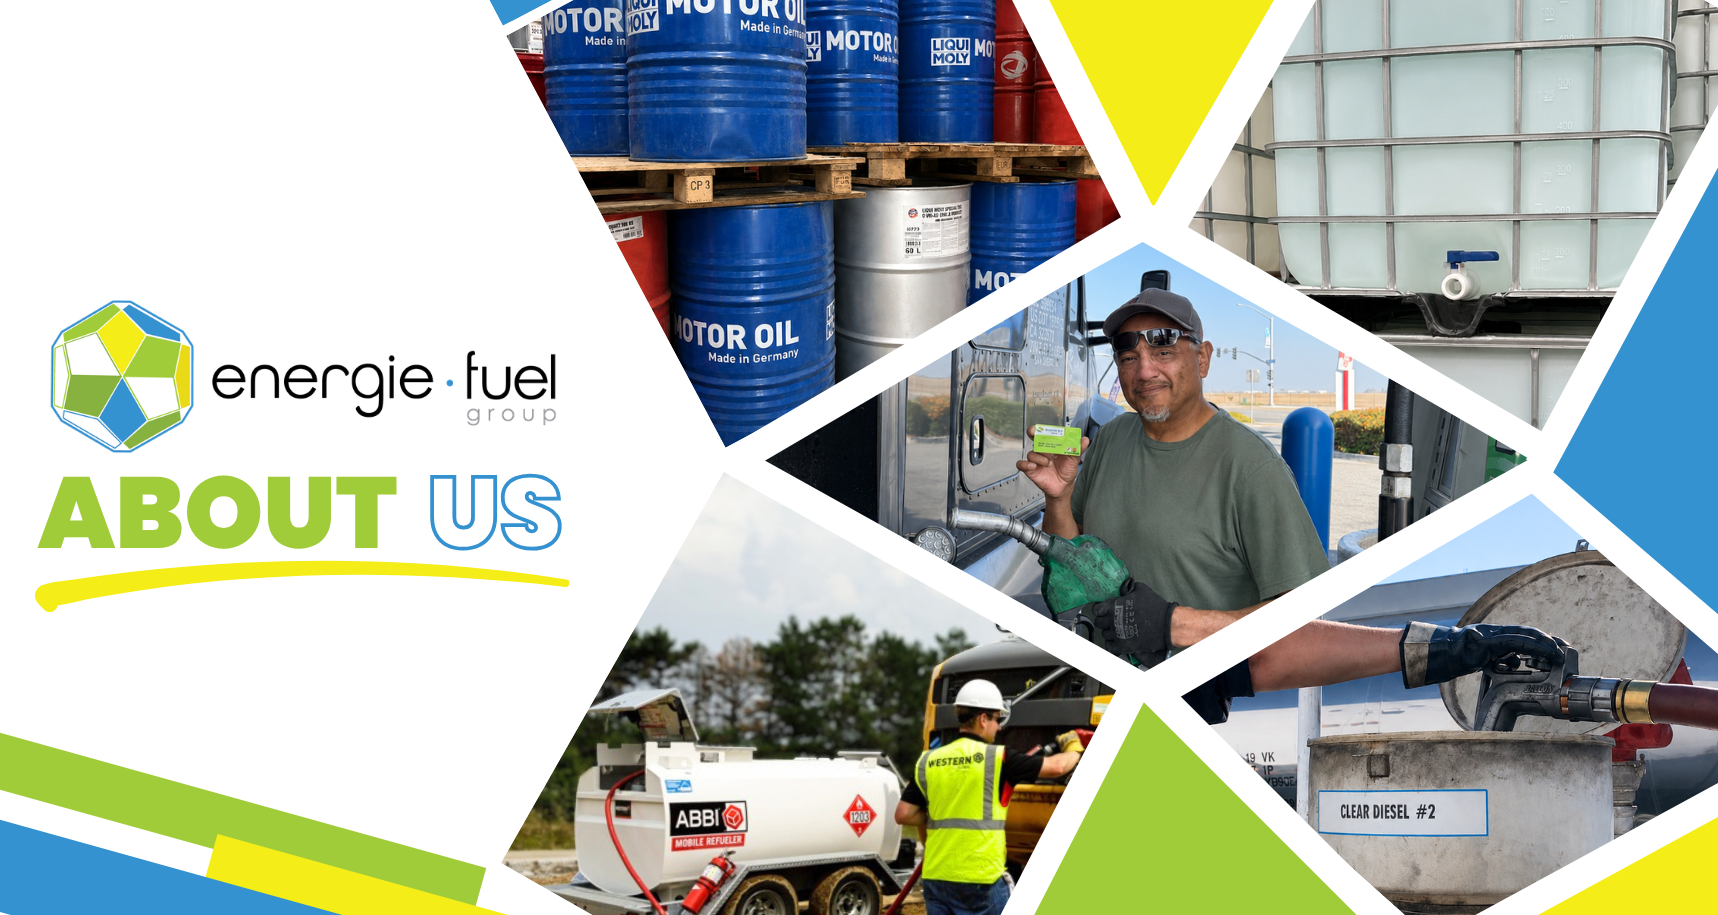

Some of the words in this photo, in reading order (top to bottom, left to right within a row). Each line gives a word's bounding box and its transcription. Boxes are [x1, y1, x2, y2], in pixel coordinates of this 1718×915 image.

[544, 7, 624, 37] MOTOR
[740, 19, 770, 33] Made
[772, 22, 781, 34] in
[585, 36, 613, 46] Made
[616, 36, 626, 46] in
[826, 30, 892, 53] MOTOR
[932, 39, 969, 51] LIQUI
[932, 52, 969, 64] MOLY
[1557, 121, 1573, 130] 400
[690, 180, 702, 191] CP
[704, 180, 710, 190] 3
[674, 312, 748, 350] MOTOR
[754, 319, 799, 349] OIL
[708, 351, 736, 364] Made
[739, 354, 750, 364] in
[752, 349, 799, 364] Germany
[928, 755, 972, 768] WESTERN
[1261, 751, 1275, 762] VK
[851, 811, 870, 823] 1203
[1340, 804, 1370, 819] CLEAR
[1373, 804, 1410, 819] DIESEL
[1416, 803, 1436, 820] #2
[675, 809, 719, 829] ABBI
[675, 837, 703, 848] MOBILE
[706, 835, 742, 846] REFUELER
